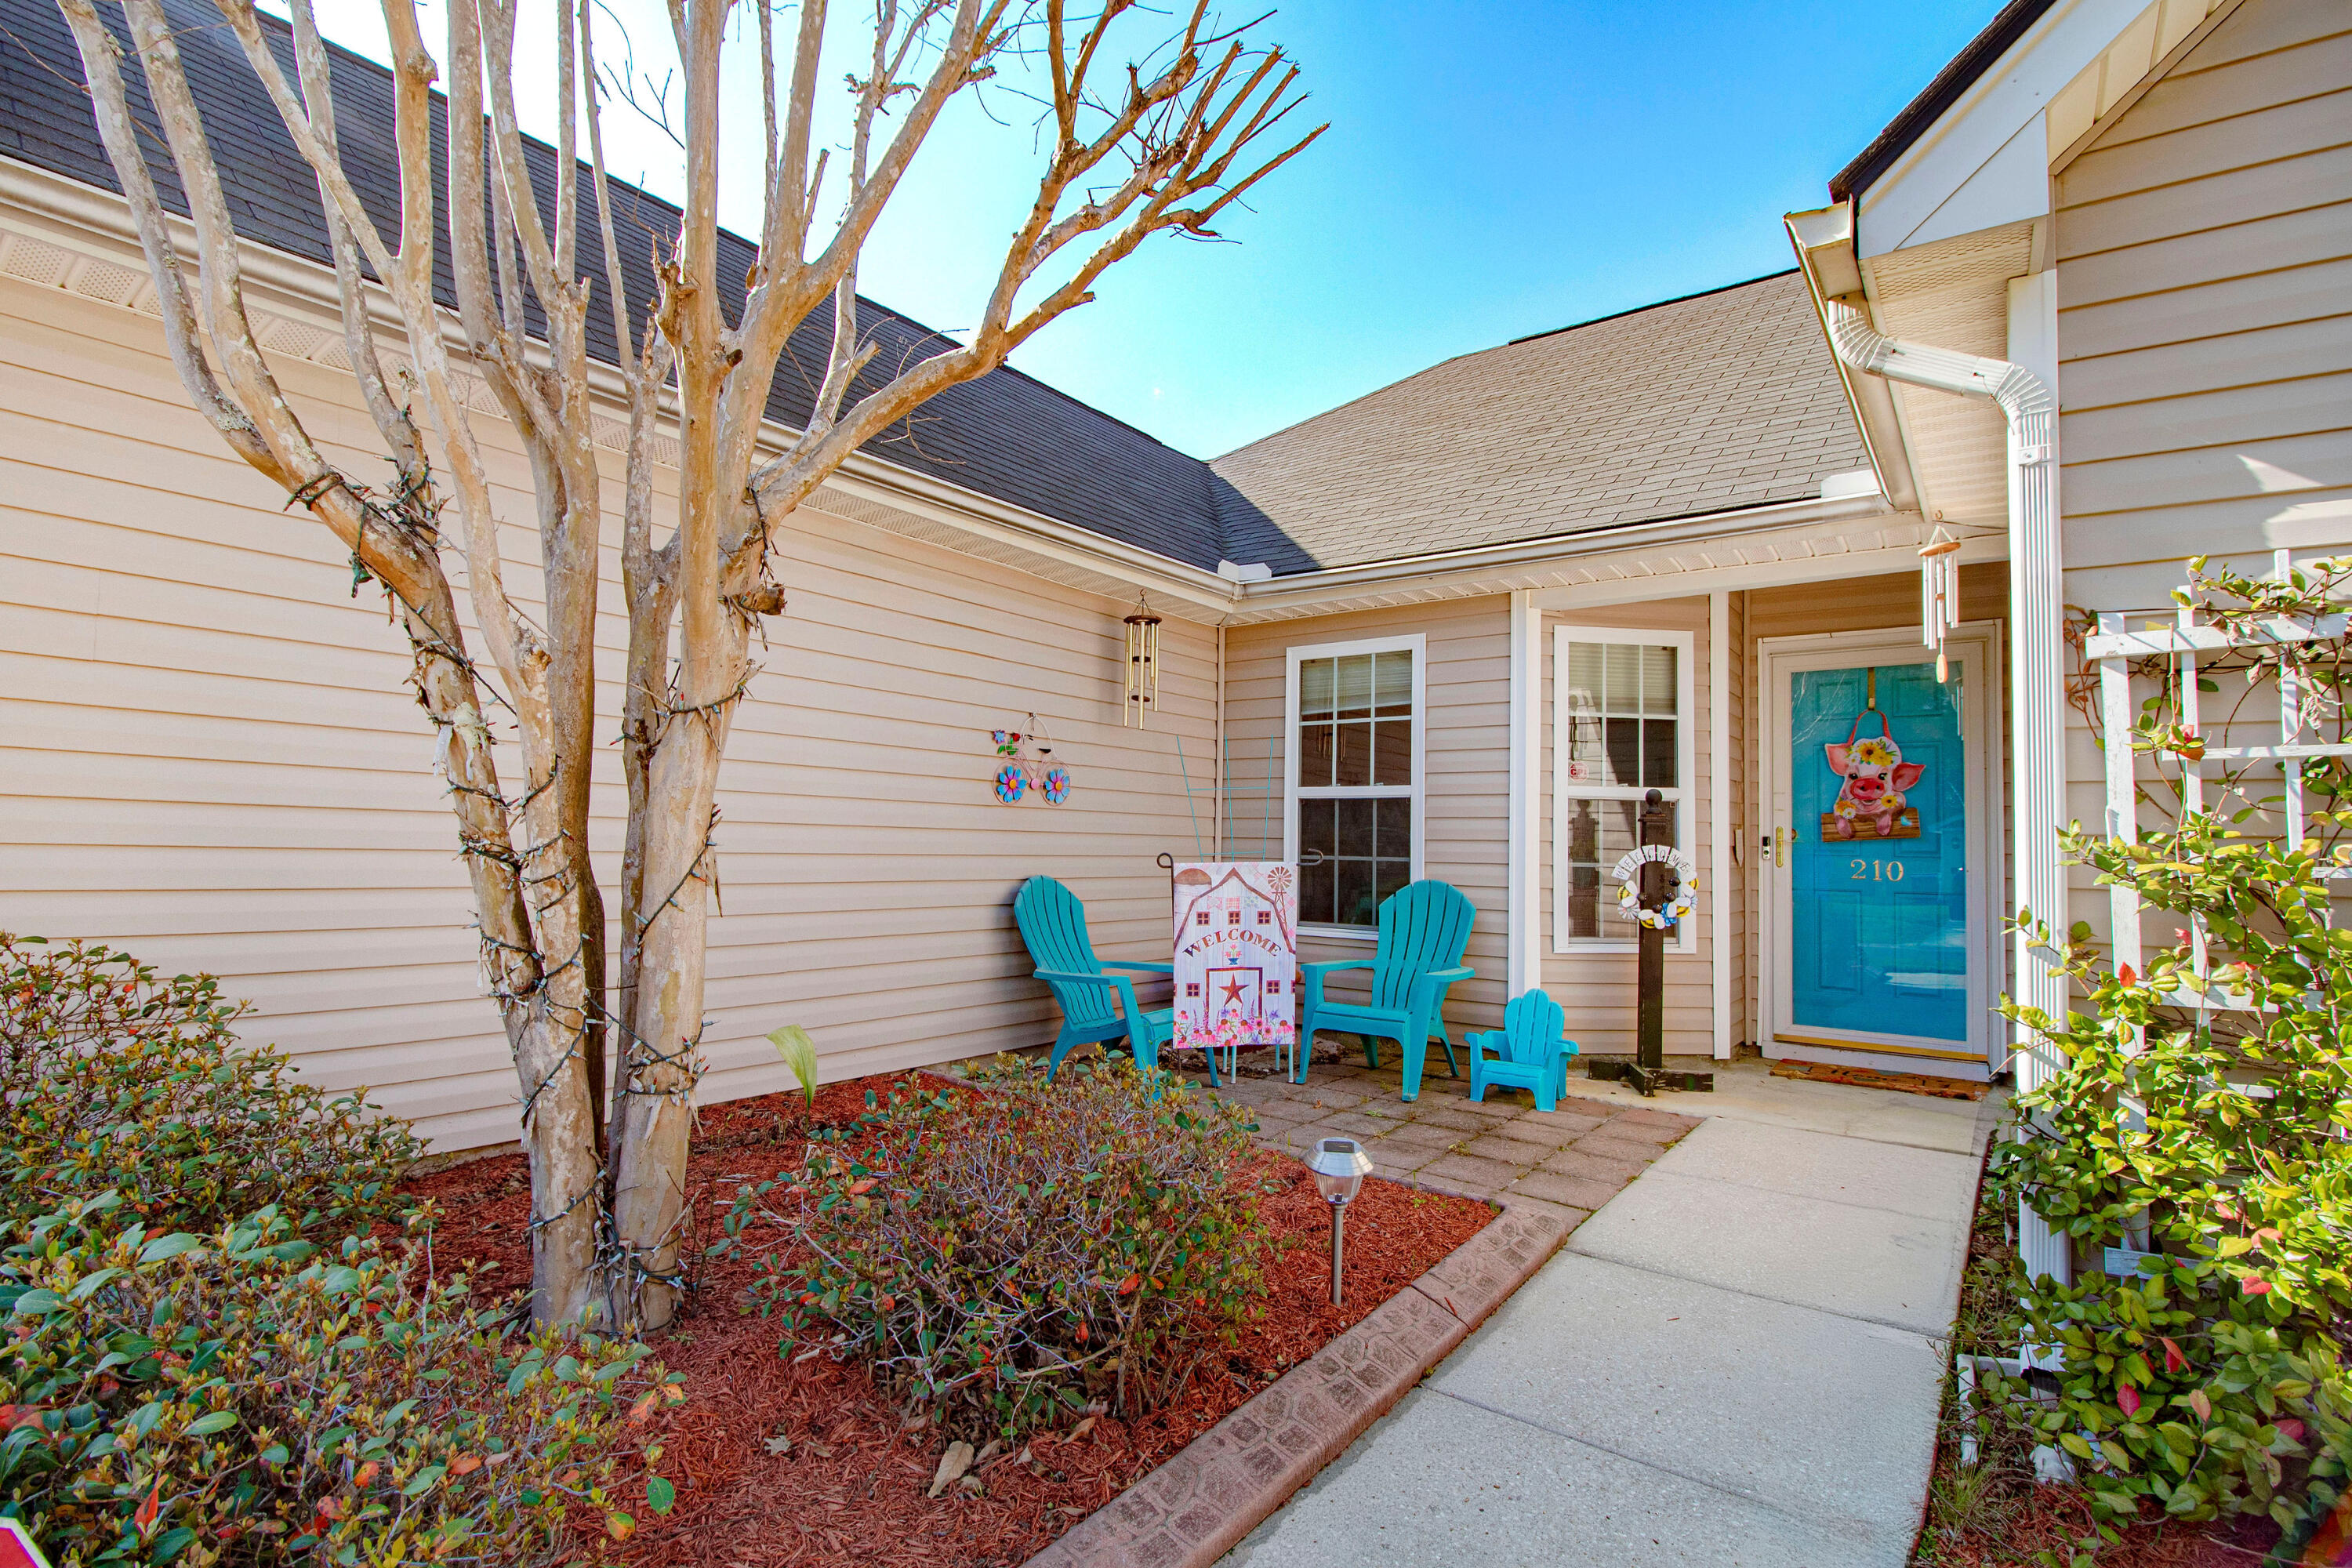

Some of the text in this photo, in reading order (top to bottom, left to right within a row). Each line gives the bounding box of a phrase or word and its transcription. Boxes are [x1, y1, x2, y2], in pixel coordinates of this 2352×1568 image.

[1616, 848, 1690, 878] WELCOME
[1850, 859, 1904, 881] 210
[1182, 928, 1282, 958] WELCOME
